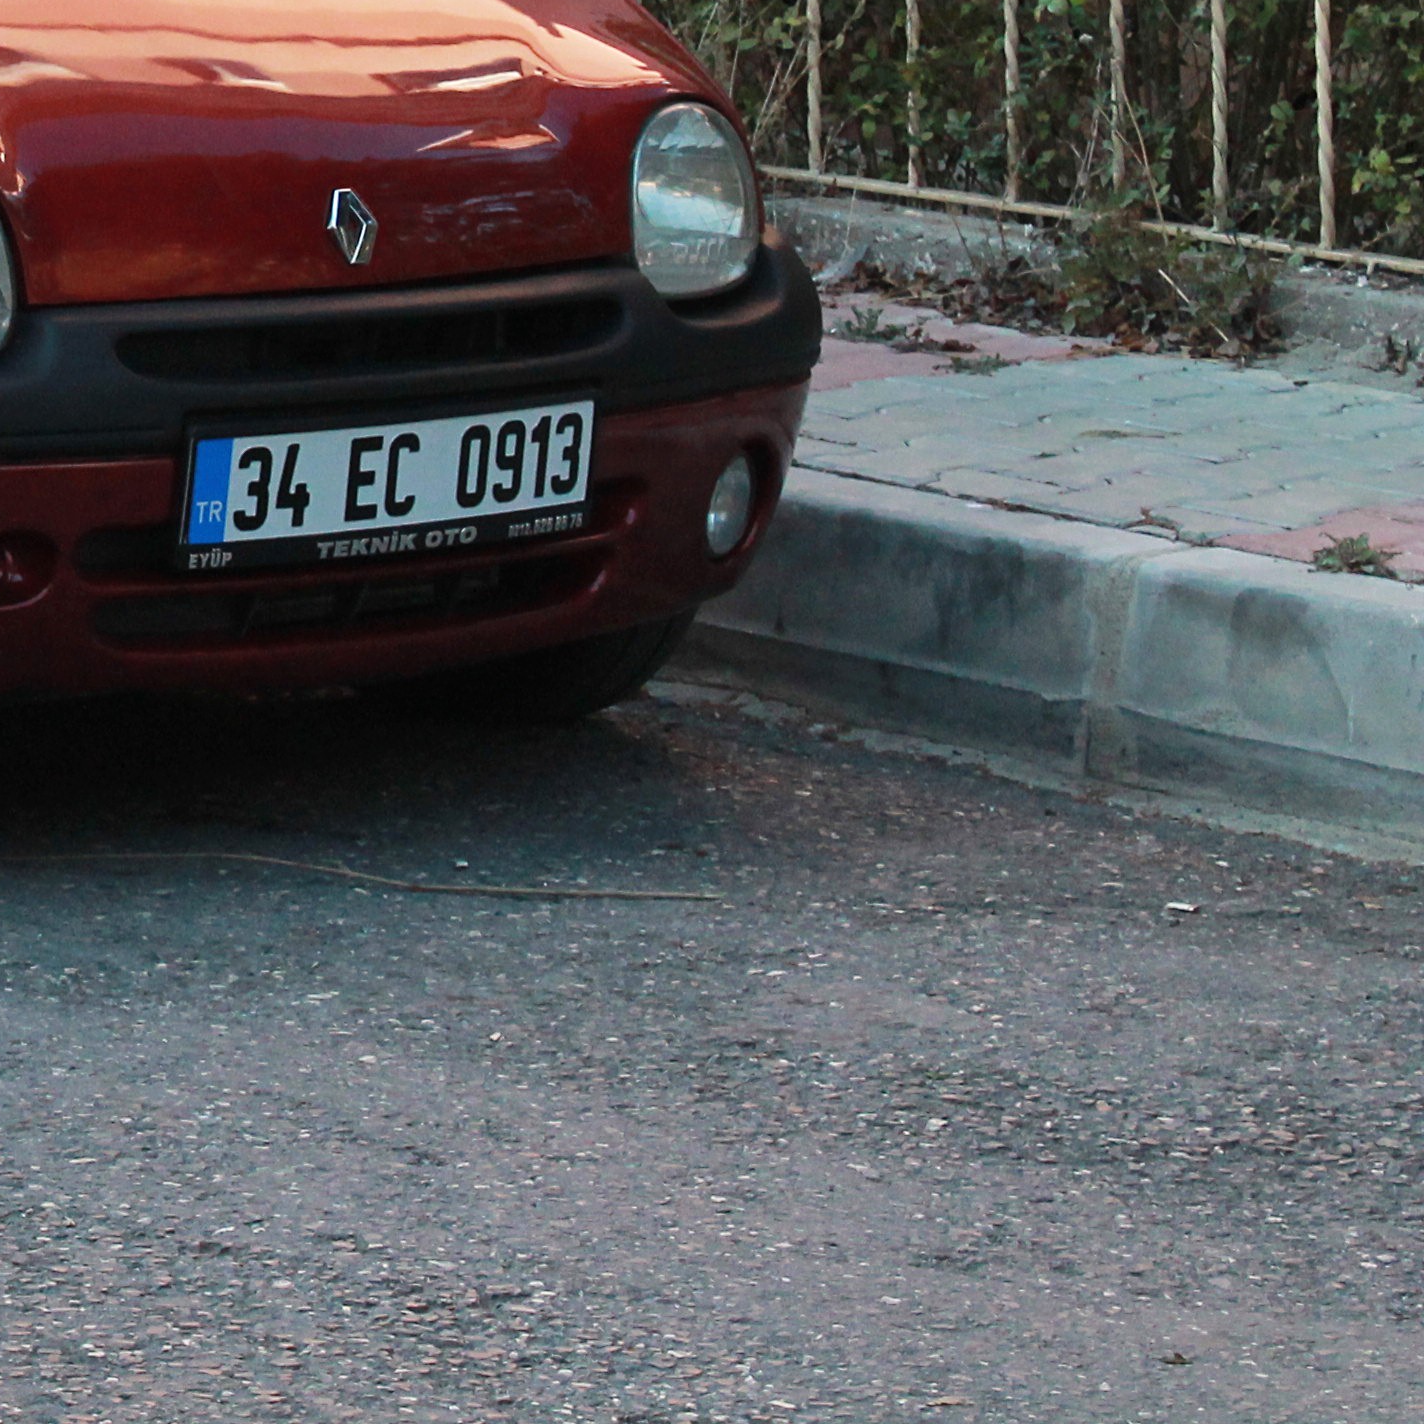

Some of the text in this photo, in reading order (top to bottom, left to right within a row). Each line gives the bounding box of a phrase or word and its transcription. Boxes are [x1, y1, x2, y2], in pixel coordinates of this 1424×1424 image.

[232, 412, 585, 532] 34 EC 0913
[197, 500, 222, 524] TR
[317, 526, 479, 560] TEKNİK OTO
[189, 548, 233, 569] EYÜP
